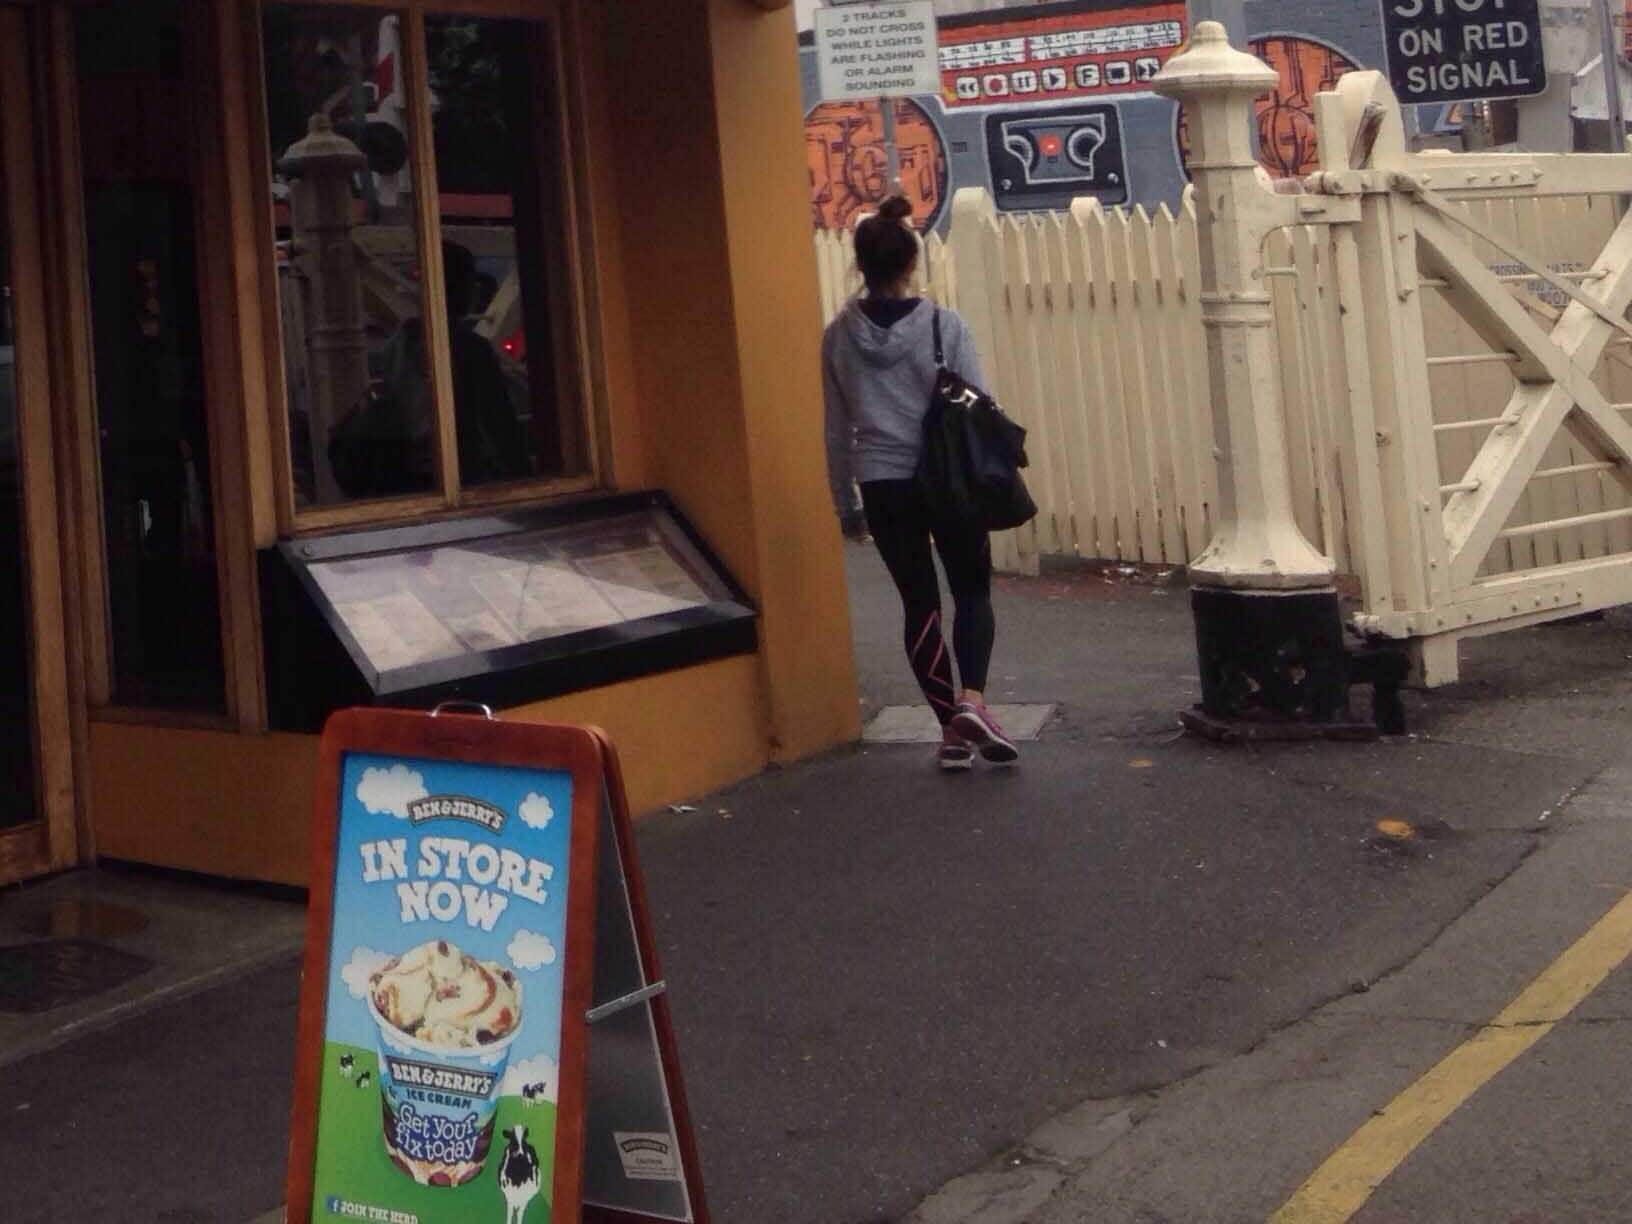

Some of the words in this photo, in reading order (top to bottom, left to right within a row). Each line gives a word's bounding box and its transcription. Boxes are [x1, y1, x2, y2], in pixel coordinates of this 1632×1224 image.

[854, 9, 906, 22] TRACKS
[849, 26, 875, 35] NOT
[879, 22, 925, 33] CROSS
[1398, 28, 1443, 56] ON
[1463, 21, 1528, 51] RED
[831, 39, 872, 50] WHILE
[875, 36, 923, 47] LIGHTS
[831, 55, 856, 64] ARE
[860, 50, 925, 62] FLASHING
[868, 65, 913, 75] ALARM
[1406, 59, 1530, 93] SIGNAL
[845, 79, 915, 91] SOUNDING
[360, 838, 408, 882] IN
[418, 837, 554, 904] STORE
[397, 881, 508, 932] NOW
[406, 1089, 425, 1102] ICE
[427, 1092, 472, 1109] CREAM
[424, 1136, 478, 1163] today
[340, 1200, 368, 1217] JOIN
[368, 1206, 389, 1221] THE
[389, 1210, 418, 1224] HERD
